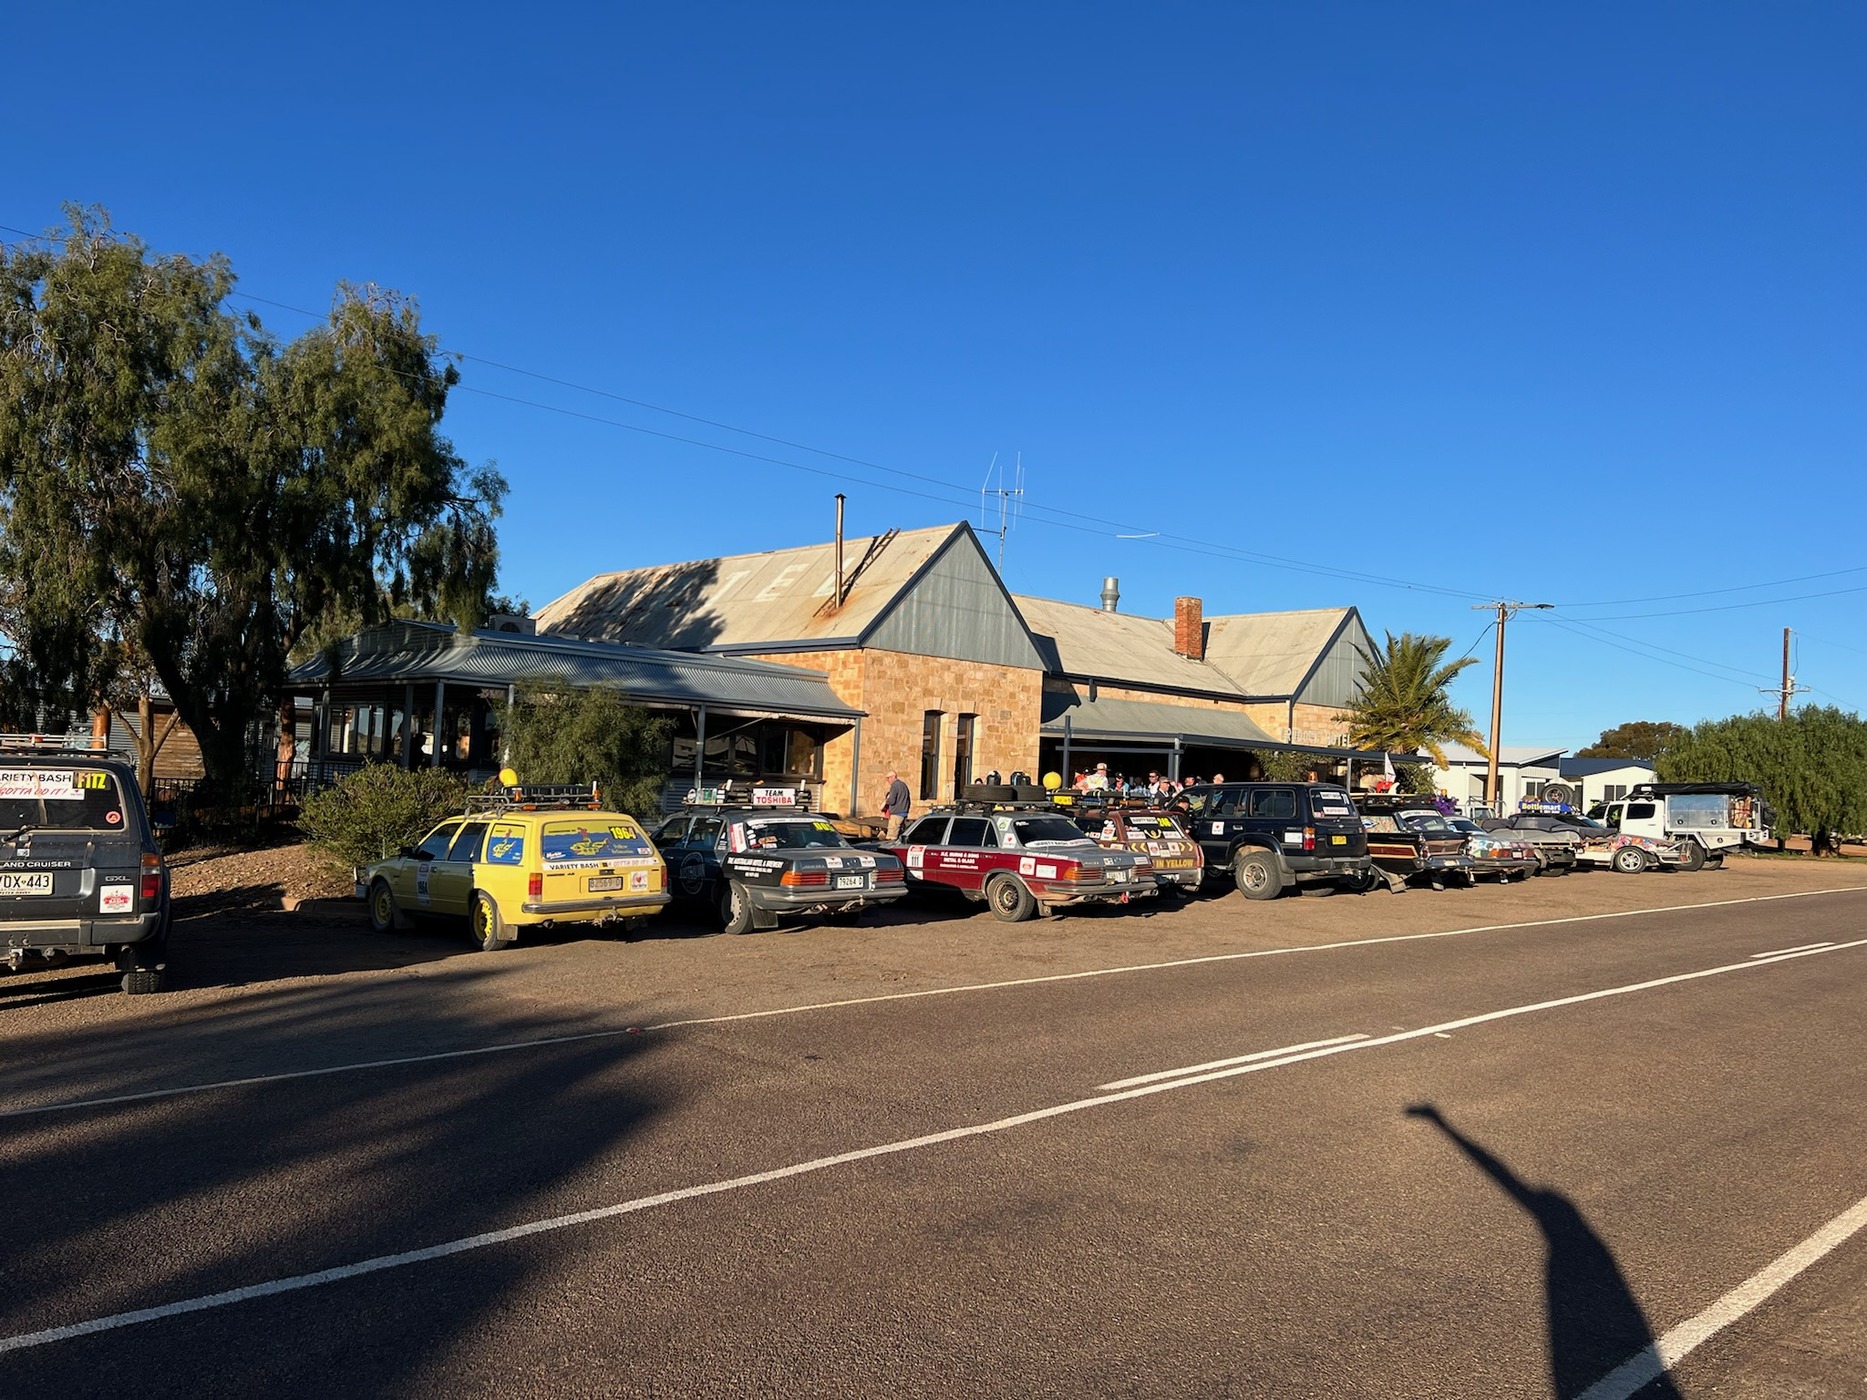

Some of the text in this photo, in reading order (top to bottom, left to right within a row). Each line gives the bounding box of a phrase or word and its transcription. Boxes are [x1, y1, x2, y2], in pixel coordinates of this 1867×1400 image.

[39, 773, 72, 783] BASH
[765, 789, 784, 797] TEAM
[756, 796, 793, 804] TOSHIBA
[1521, 803, 1562, 811] Bottlemart
[610, 826, 637, 839] 1964
[549, 863, 580, 871] VARIETY
[580, 861, 599, 869] BASH
[1155, 859, 1195, 868] IN YELLOW
